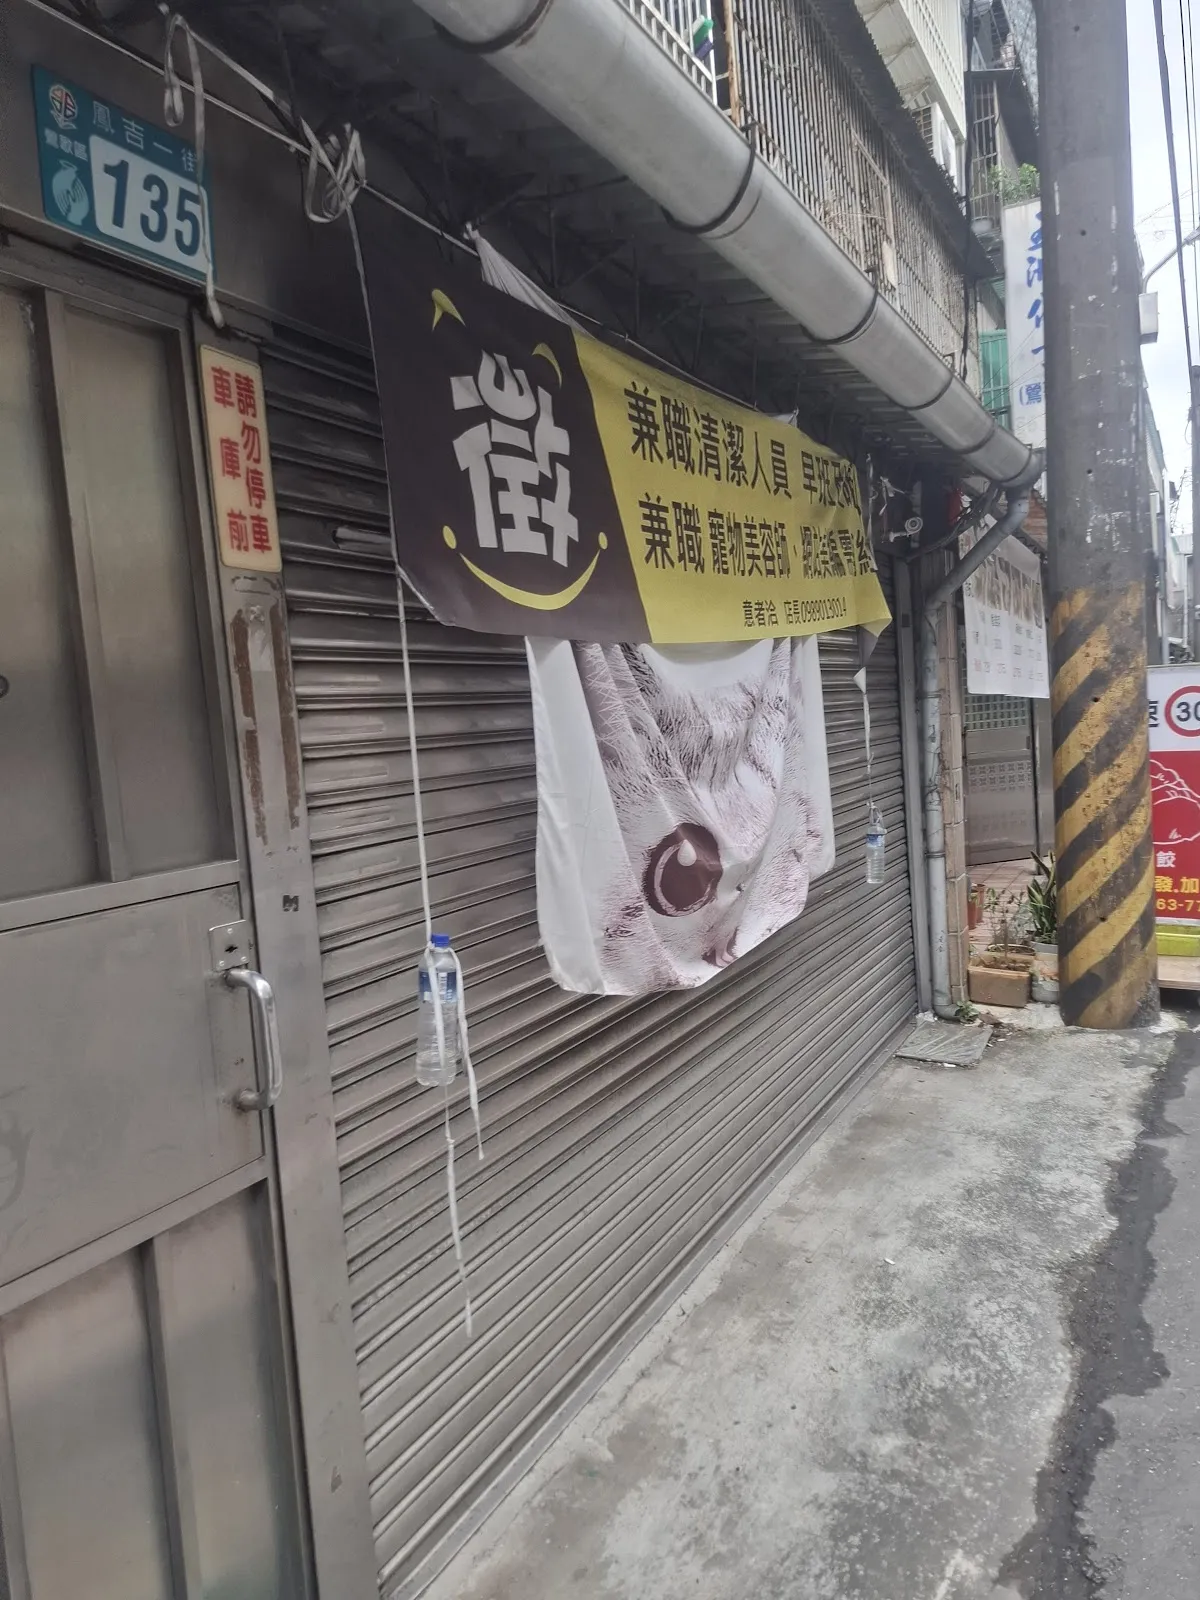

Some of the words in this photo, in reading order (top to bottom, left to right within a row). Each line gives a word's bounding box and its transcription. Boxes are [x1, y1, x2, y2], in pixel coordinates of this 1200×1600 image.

[103, 159, 202, 256] 135
[211, 366, 250, 552] 車庫前
[235, 372, 272, 553] 請勿停車
[624, 381, 792, 500] 兼職清潔人員
